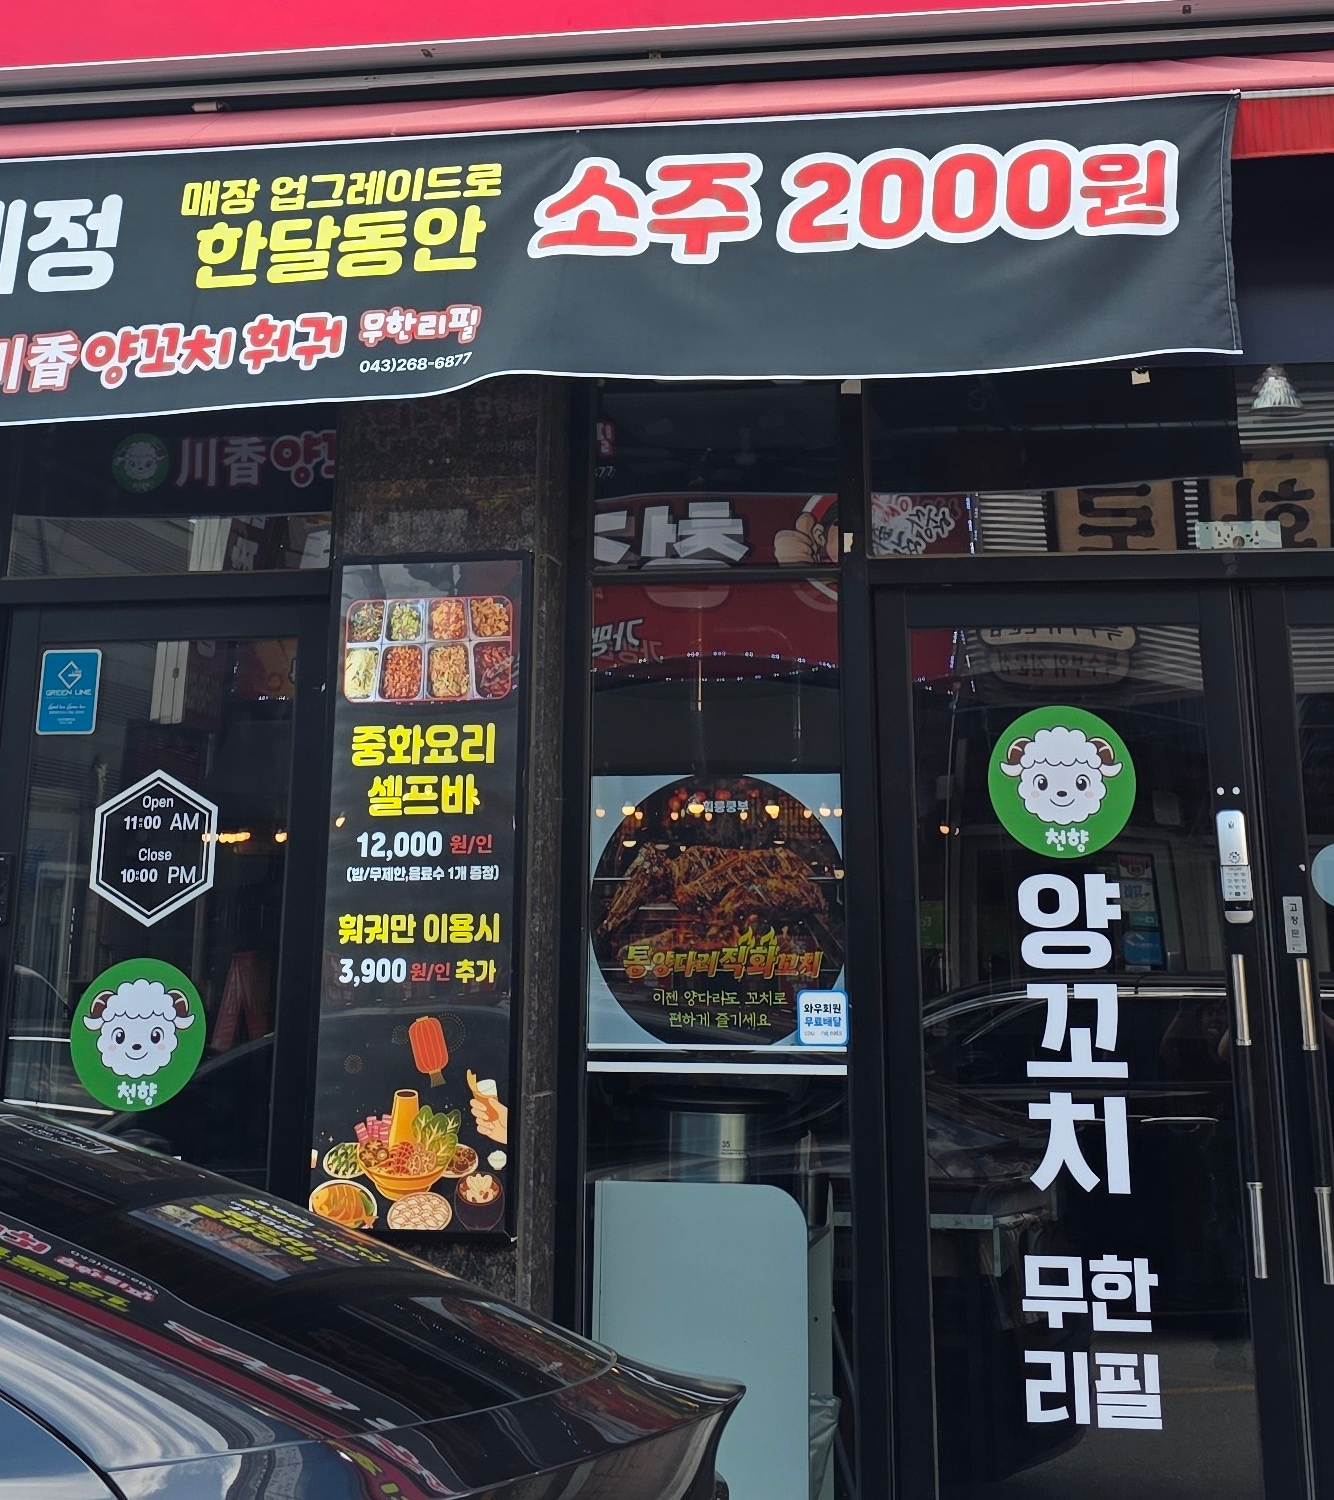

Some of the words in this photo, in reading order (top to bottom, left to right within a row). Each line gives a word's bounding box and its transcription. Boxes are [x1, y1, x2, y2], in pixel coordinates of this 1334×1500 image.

[180, 177, 261, 217] 매장
[270, 162, 503, 211] 업그레이드로
[529, 153, 762, 265] 소주
[777, 139, 1179, 253] 2000원
[193, 206, 488, 289] 한달동안
[358, 304, 482, 346] 무한리필
[82, 323, 236, 390] 양꼬치
[240, 312, 348, 374] 훠궈
[358, 351, 473, 374] 043)268-6877
[351, 722, 496, 767] 중화요리
[142, 795, 174, 812] Open
[367, 773, 479, 817] 셀프바
[124, 815, 162, 830] 11:00
[170, 812, 200, 831] AM
[138, 848, 172, 861] Close
[356, 831, 443, 862] 12,000
[449, 834, 493, 855] 원/인
[1045, 827, 1089, 853] 천향
[120, 868, 158, 883] 10:00
[167, 865, 197, 884] PM
[447, 866, 467, 881] 1개
[338, 913, 417, 945] 훠궈만
[423, 912, 500, 944] 이용시
[338, 957, 407, 987] 3,900
[410, 962, 451, 981] 원/인
[455, 958, 497, 984] 추가
[745, 991, 788, 1006] 꼬치로
[803, 1004, 842, 1014] 와우회원
[669, 1011, 710, 1028] 편하게
[715, 1011, 772, 1028] 즐기세요
[804, 1016, 842, 1028] 무료배달
[1017, 873, 1131, 1194] 양꼬치
[117, 1081, 157, 1106] 천향
[1022, 1254, 1159, 1333] 무한
[1024, 1350, 1163, 1430] 리필
